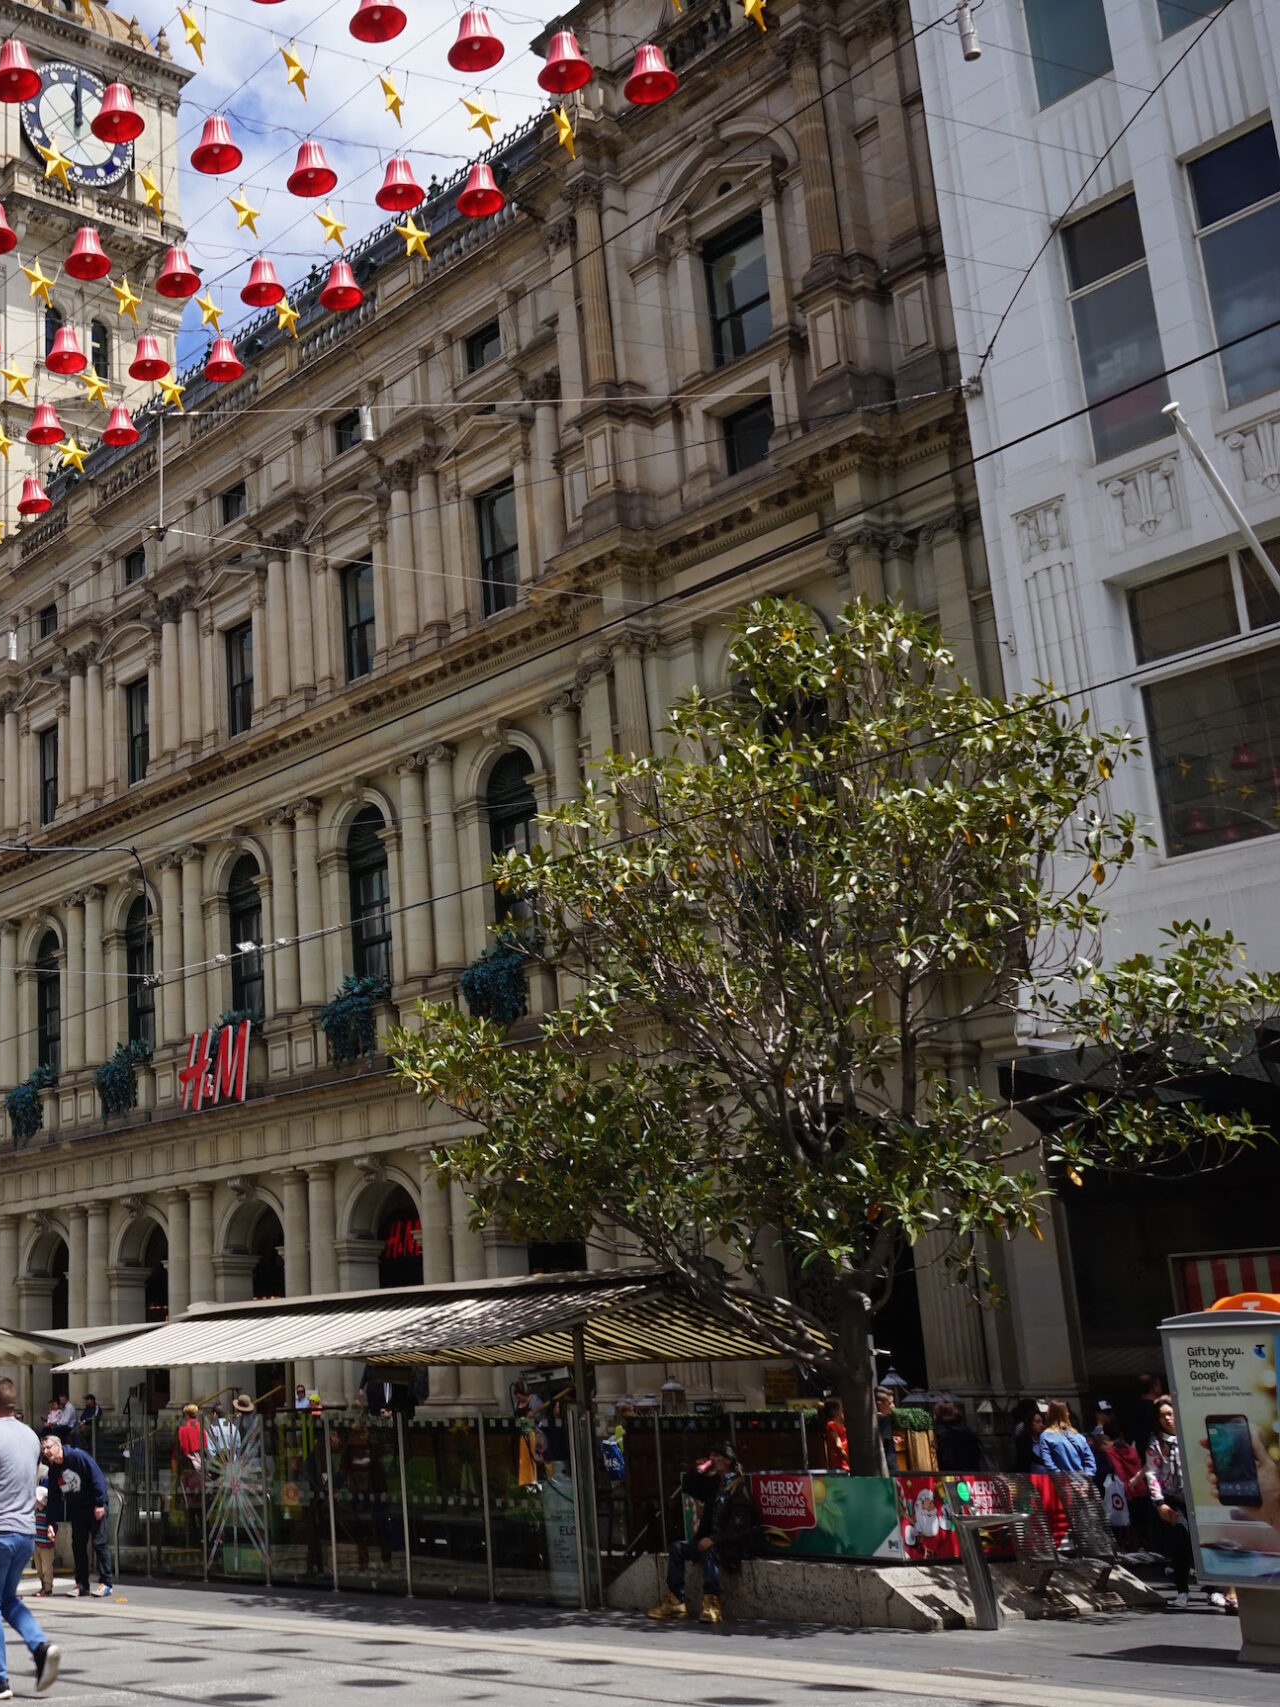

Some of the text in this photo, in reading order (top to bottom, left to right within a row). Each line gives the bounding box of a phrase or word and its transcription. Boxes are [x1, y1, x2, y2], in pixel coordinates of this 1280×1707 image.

[179, 1018, 251, 1112] H&M
[1187, 1346, 1244, 1357] Gift by you.
[1189, 1358, 1235, 1369] Phone by
[1190, 1371, 1228, 1382] Google.
[760, 1480, 803, 1495] MERRY
[761, 1495, 806, 1507] CHRISTMAS
[762, 1507, 806, 1517] MELBOURNE
